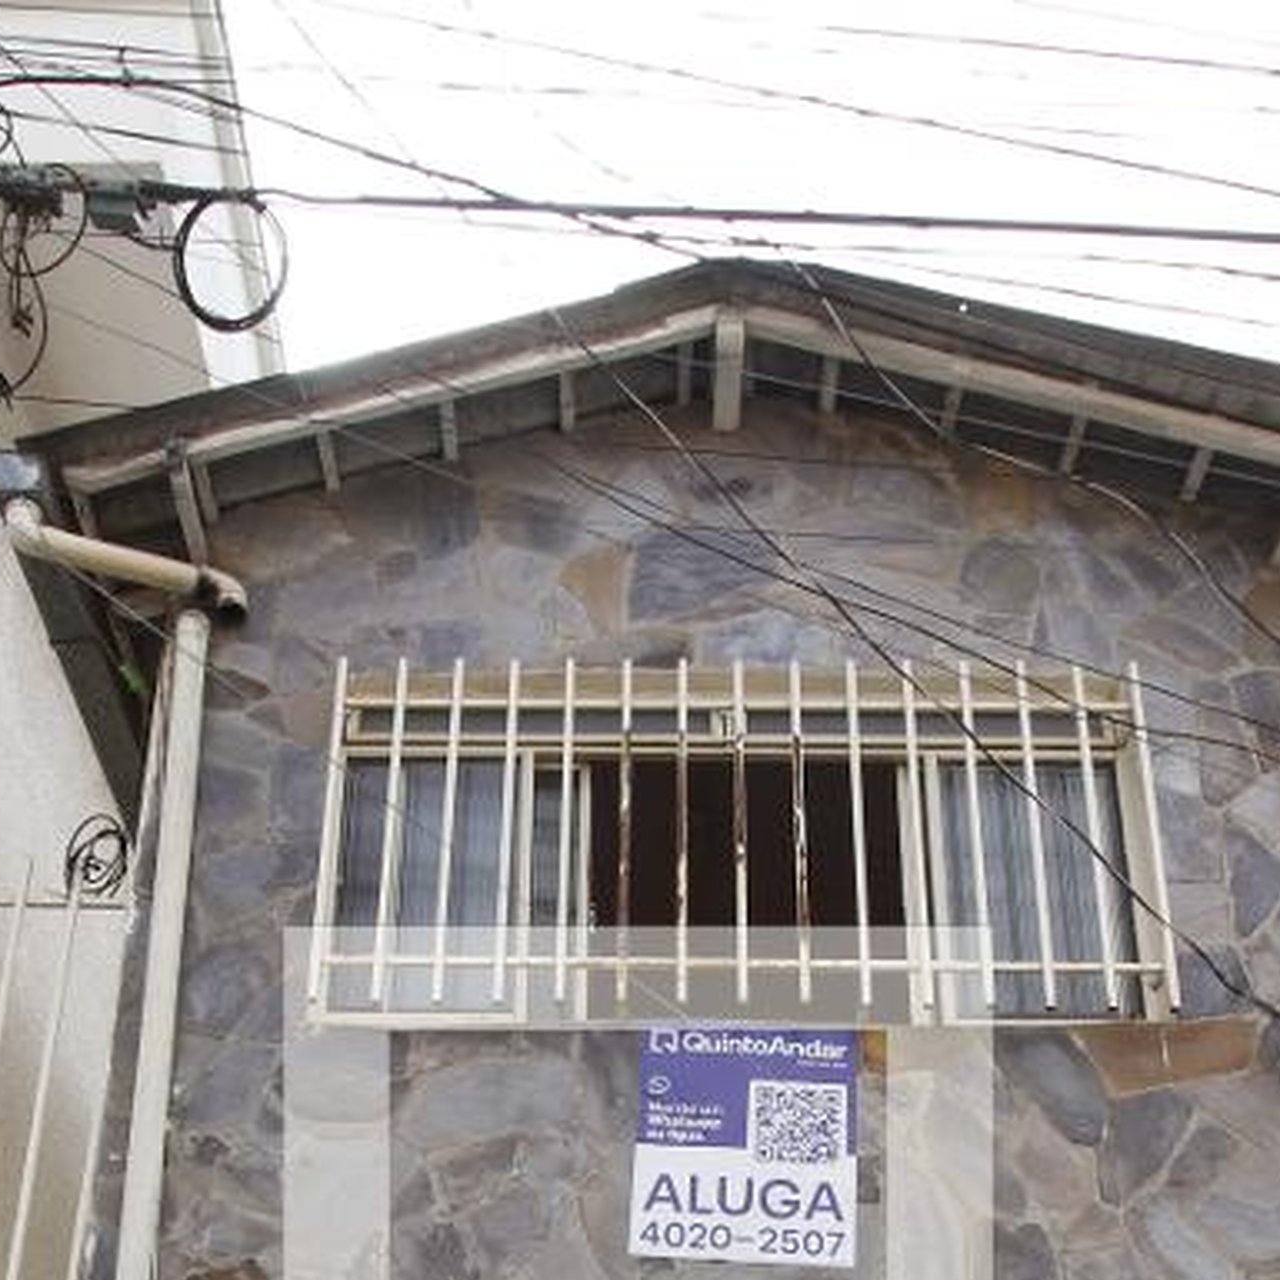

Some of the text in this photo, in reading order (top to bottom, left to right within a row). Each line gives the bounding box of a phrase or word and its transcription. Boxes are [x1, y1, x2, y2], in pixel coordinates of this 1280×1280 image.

[681, 1031, 849, 1060] QuintoAndar
[643, 1173, 844, 1222] ALUGA
[639, 1222, 846, 1257] 4020-2507
